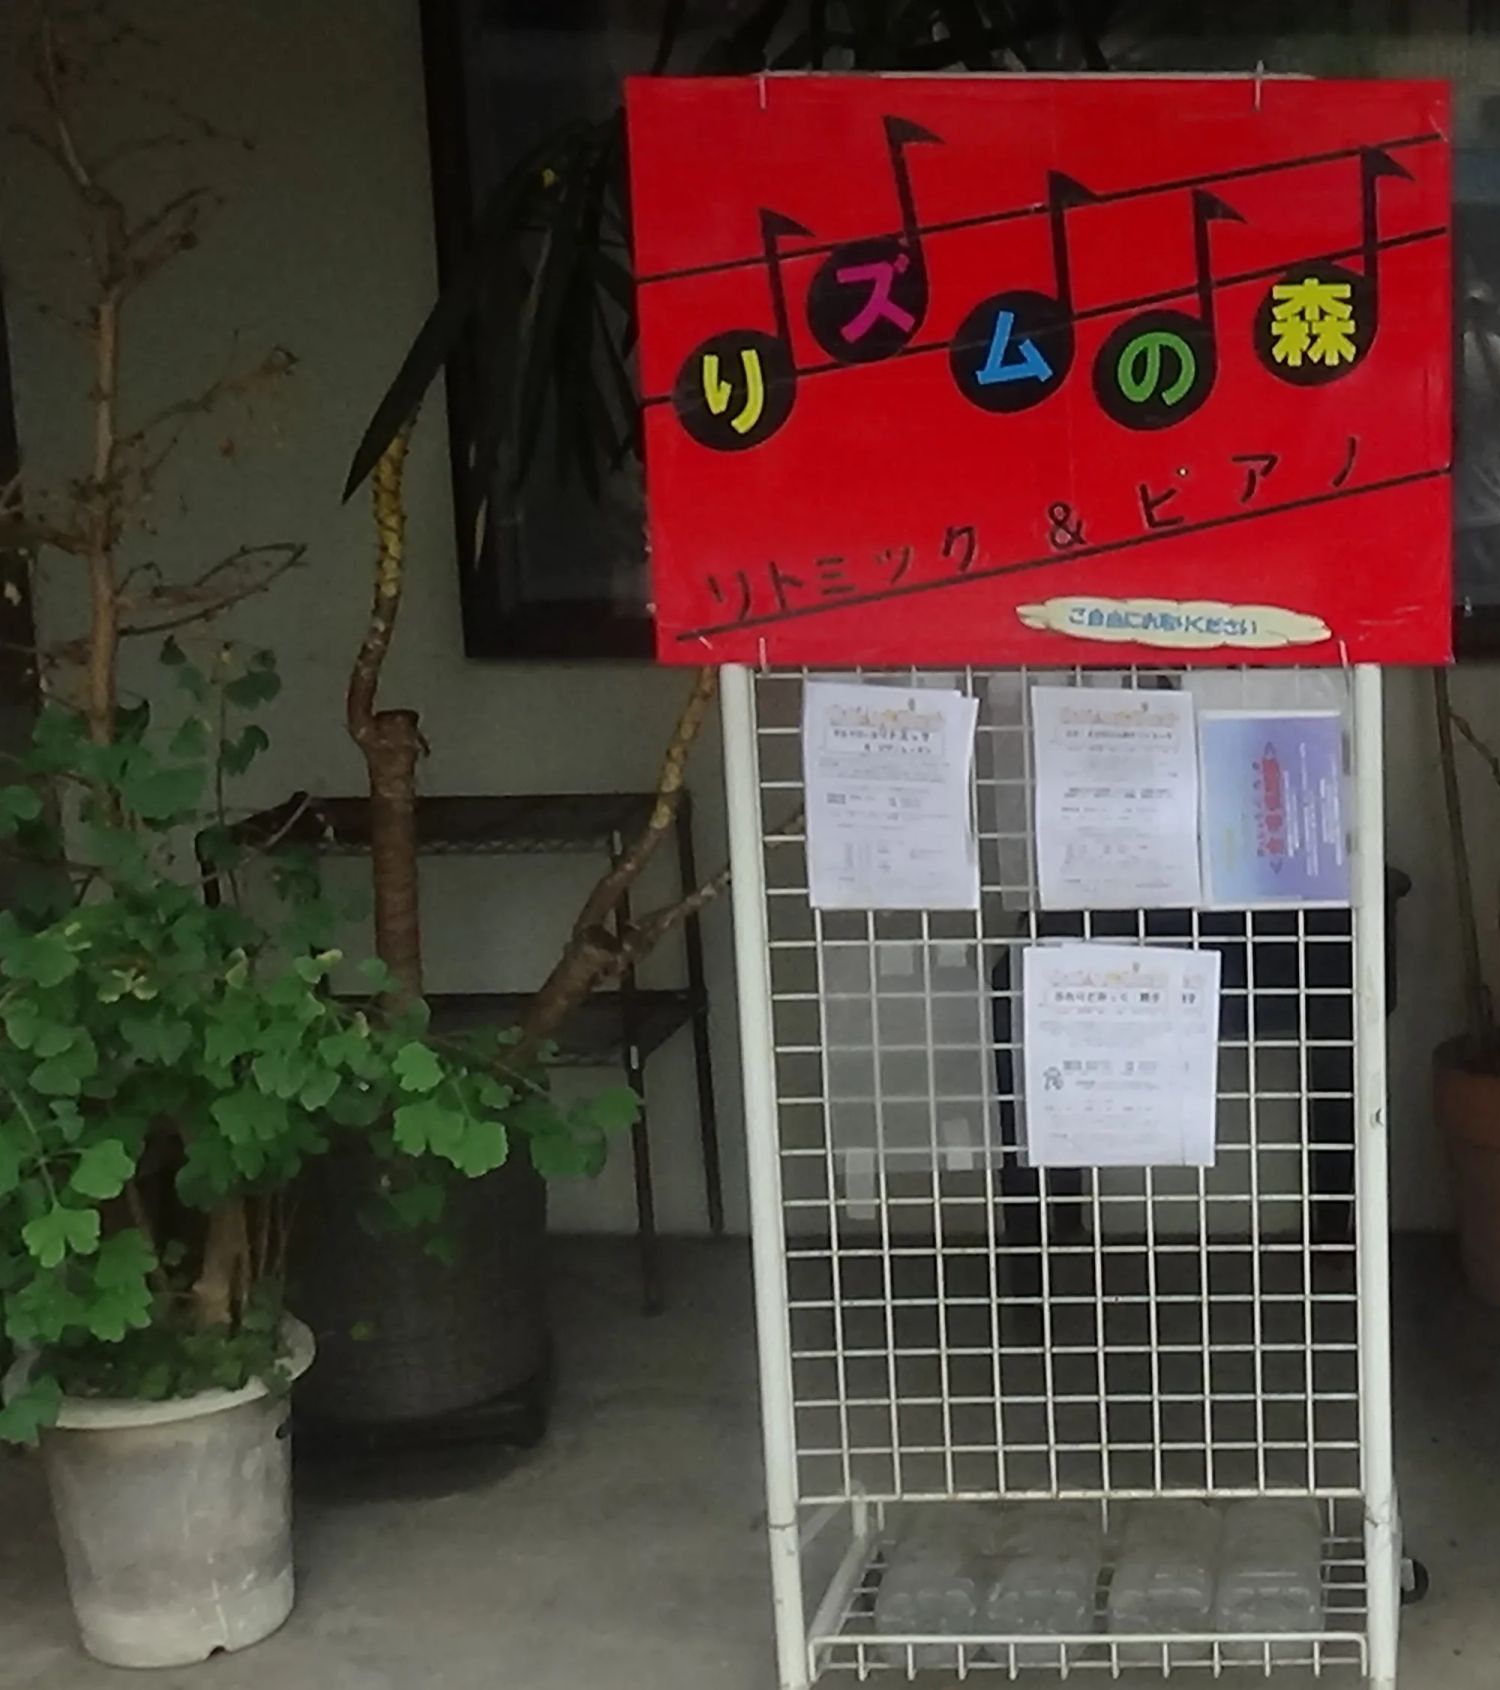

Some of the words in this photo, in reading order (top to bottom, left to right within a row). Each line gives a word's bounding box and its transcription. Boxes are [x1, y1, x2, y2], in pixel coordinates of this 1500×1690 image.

[707, 525, 976, 613] リトミック
[1048, 502, 1086, 550] &
[1140, 437, 1356, 527] ピアノ
